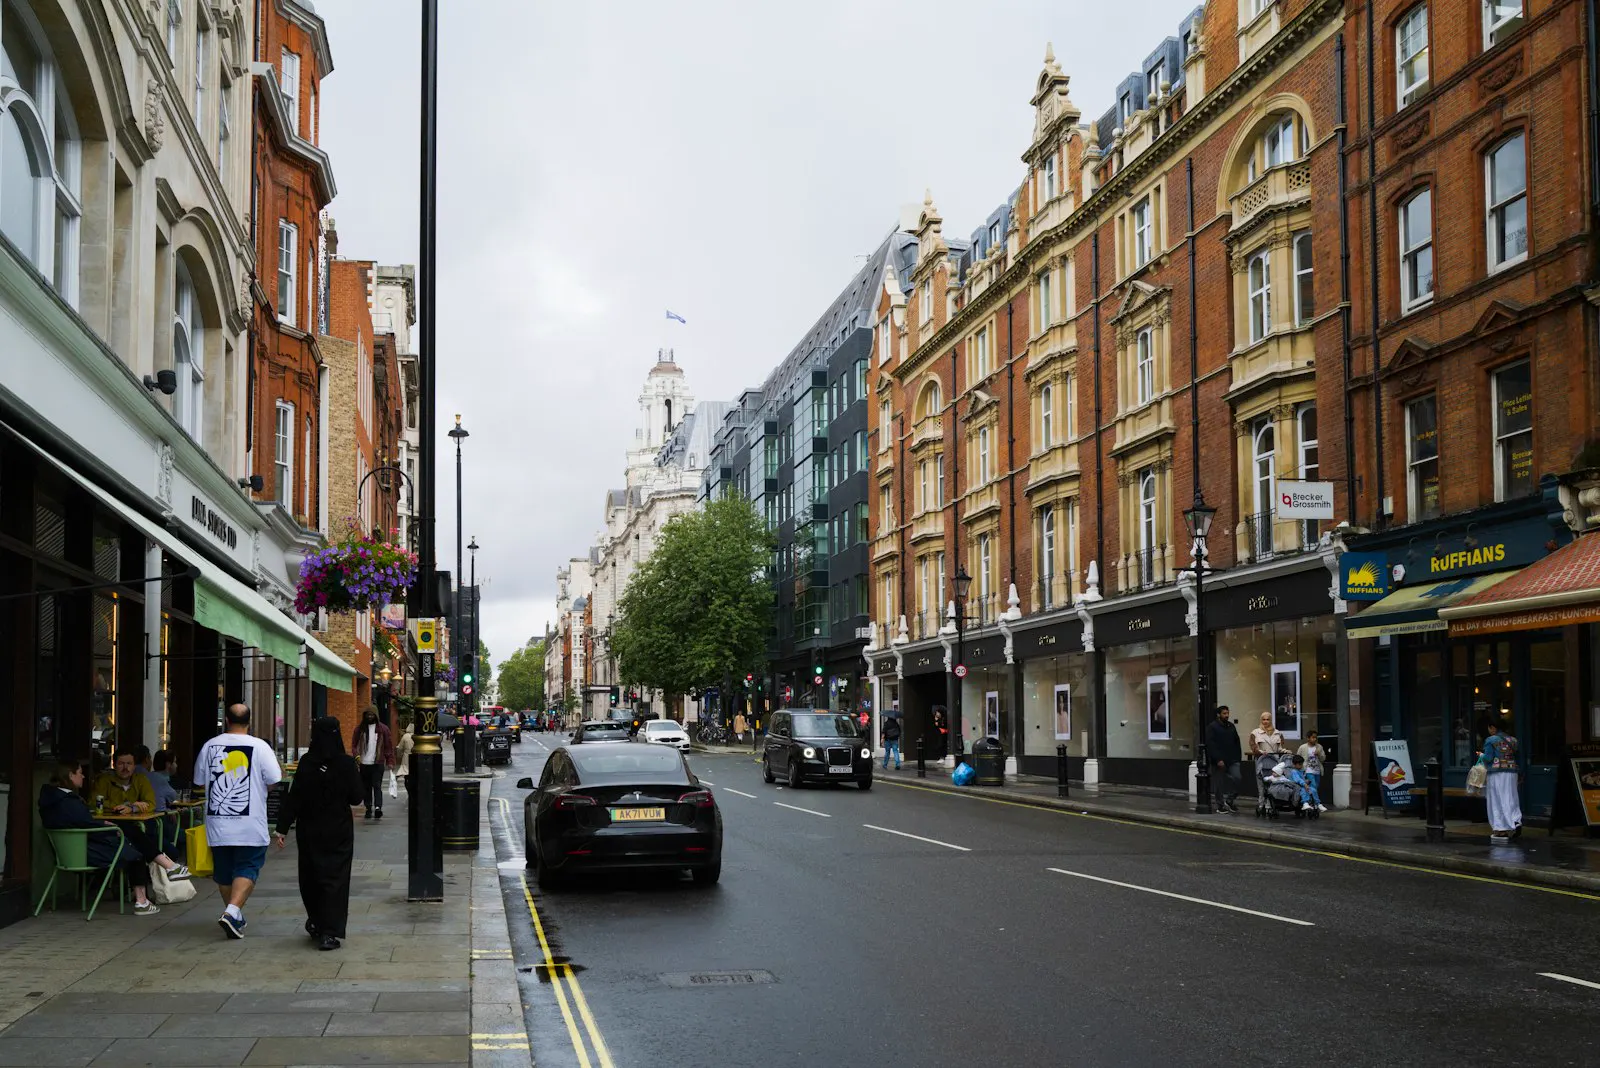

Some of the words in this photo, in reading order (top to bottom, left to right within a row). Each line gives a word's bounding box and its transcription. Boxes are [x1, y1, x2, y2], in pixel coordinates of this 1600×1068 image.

[1292, 493, 1323, 501] Brecker
[1292, 500, 1332, 509] Grossmith
[191, 495, 206, 527] LINA
[1430, 543, 1506, 573] RUFFIANS
[1451, 623, 1464, 632] ALL
[1466, 621, 1480, 631] DAY
[1482, 617, 1509, 628] EATING
[1512, 612, 1559, 625] BREAKFAST
[1561, 607, 1592, 620] LUNCH
[957, 667, 966, 675] 20
[1378, 744, 1406, 752] RUFFIANS
[619, 809, 640, 819] AK71
[643, 808, 661, 818] VUW
